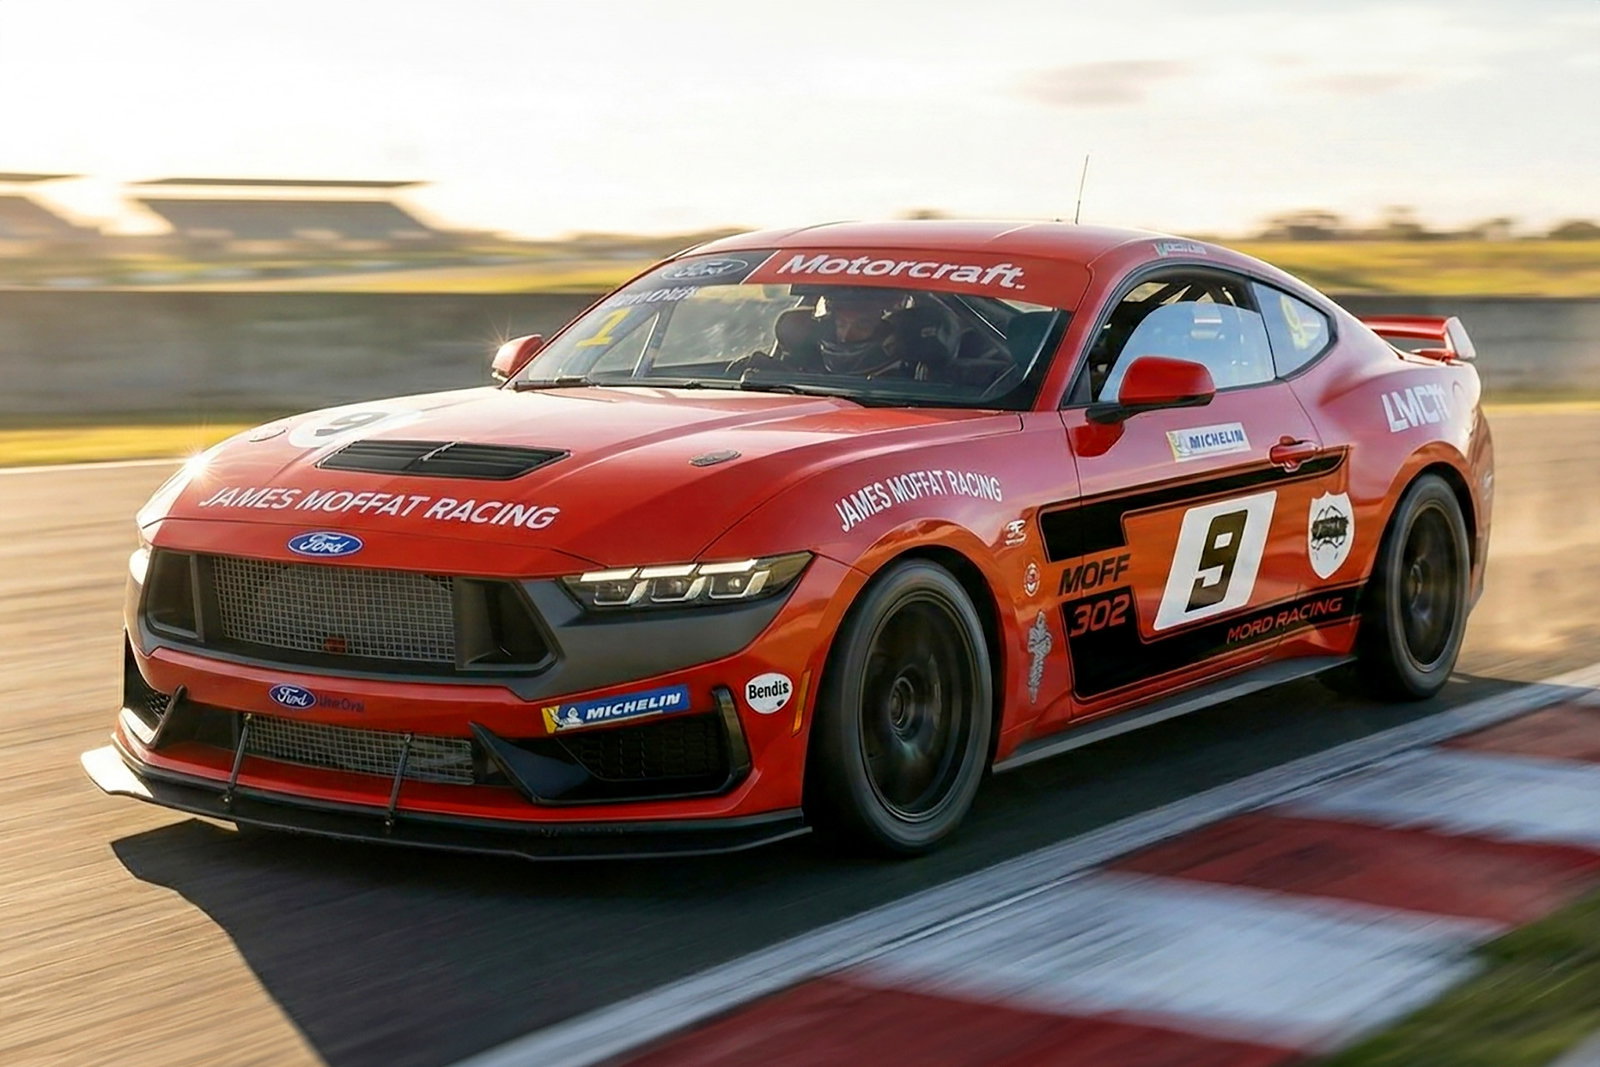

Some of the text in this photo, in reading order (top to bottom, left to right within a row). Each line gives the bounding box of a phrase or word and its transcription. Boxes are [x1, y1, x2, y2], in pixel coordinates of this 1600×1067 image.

[576, 308, 631, 347] 1
[1280, 294, 1308, 349] 9
[314, 411, 390, 437] 9
[1189, 429, 1244, 449] MICHELIN
[199, 487, 561, 530] JAMES MOFFAT RACING
[834, 470, 1002, 533] JAMES MOFFAT RACING
[299, 532, 351, 554] Ford
[1184, 509, 1249, 613] 9
[1058, 553, 1132, 597] MOFF
[1069, 593, 1131, 638] 302
[1226, 596, 1343, 644] MORD RACING
[586, 692, 682, 721] MICHELIN
[748, 680, 790, 700] Bendis
